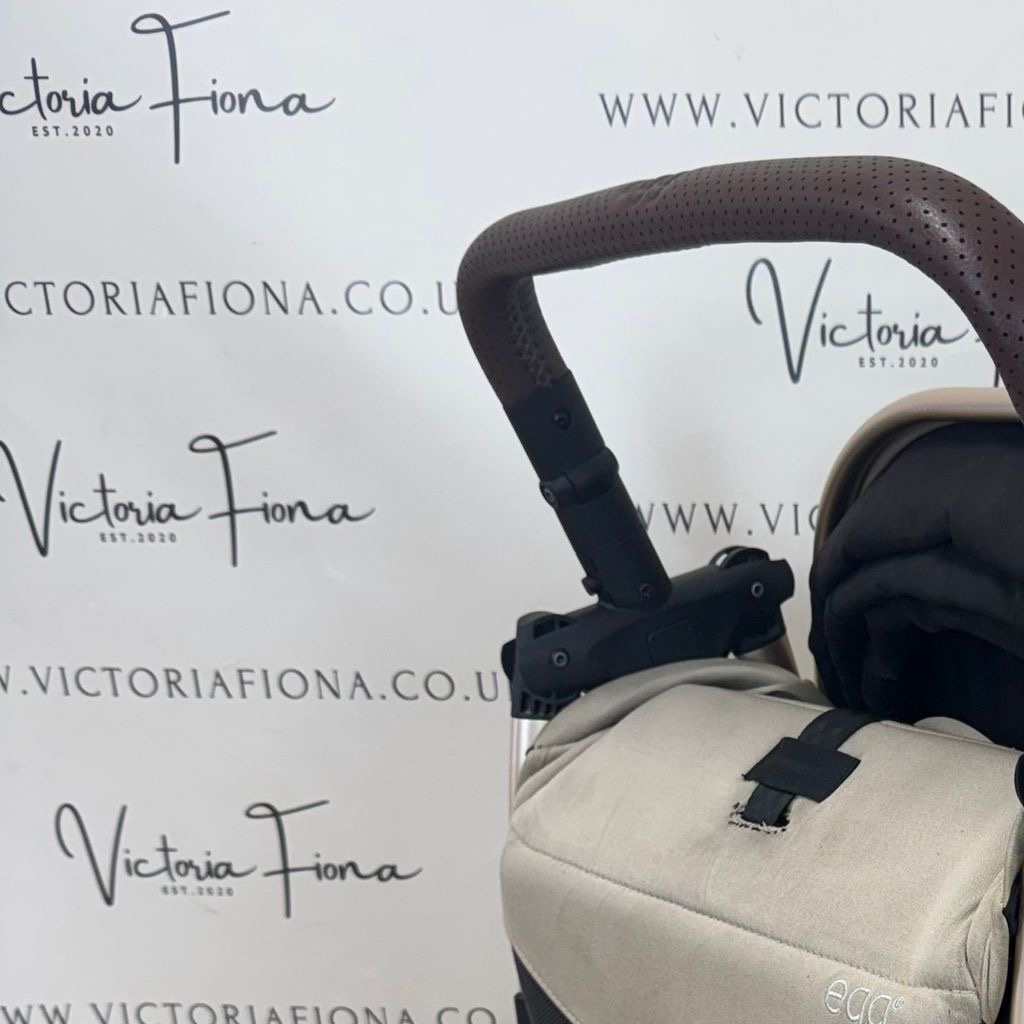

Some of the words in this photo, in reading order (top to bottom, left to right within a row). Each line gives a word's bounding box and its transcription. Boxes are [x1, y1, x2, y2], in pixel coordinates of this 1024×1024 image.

[0, 57, 142, 120] ctoria
[131, 10, 336, 164] Fiona
[31, 125, 114, 137] EST.2020
[746, 257, 970, 384] Victoria
[859, 357, 939, 368] EST.2020
[0, 439, 202, 557] Victoria
[188, 430, 376, 567] Fiona
[55, 803, 257, 907] Victoria
[244, 799, 423, 919] Fiona
